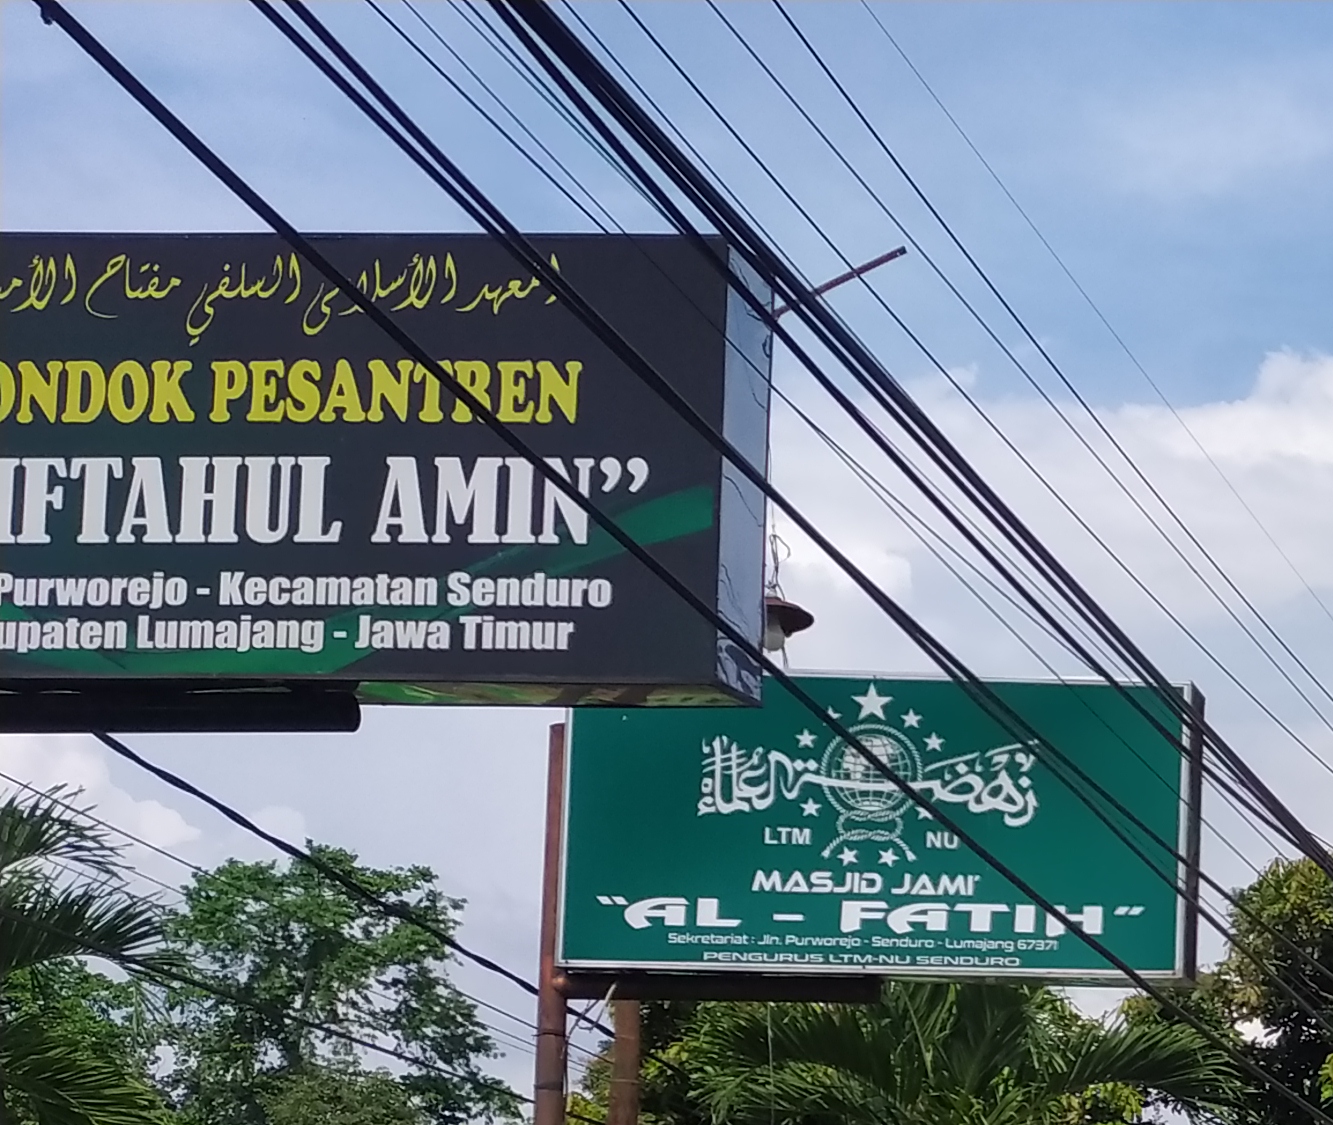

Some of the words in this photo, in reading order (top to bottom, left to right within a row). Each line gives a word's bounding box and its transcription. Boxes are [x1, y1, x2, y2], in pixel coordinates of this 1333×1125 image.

[208, 359, 583, 425] PESANTREN
[218, 571, 438, 607] Kecamatan
[447, 571, 613, 608] Senduro
[136, 615, 325, 654] Lumajang
[354, 615, 450, 650] Jawa
[458, 615, 575, 651] Timur
[763, 826, 812, 846] LTM
[926, 831, 960, 850] NU
[751, 870, 883, 894] MASJID
[667, 932, 749, 945] Sekretariat
[757, 934, 783, 946] Jln.
[785, 934, 861, 949] Purworejo
[871, 936, 935, 949] Senduro
[945, 938, 1014, 953] Lumajang
[1016, 939, 1059, 951] 67371
[702, 951, 824, 962] PENGURUS
[828, 953, 911, 964] LTM-NU
[915, 954, 1020, 967] SENDURO
